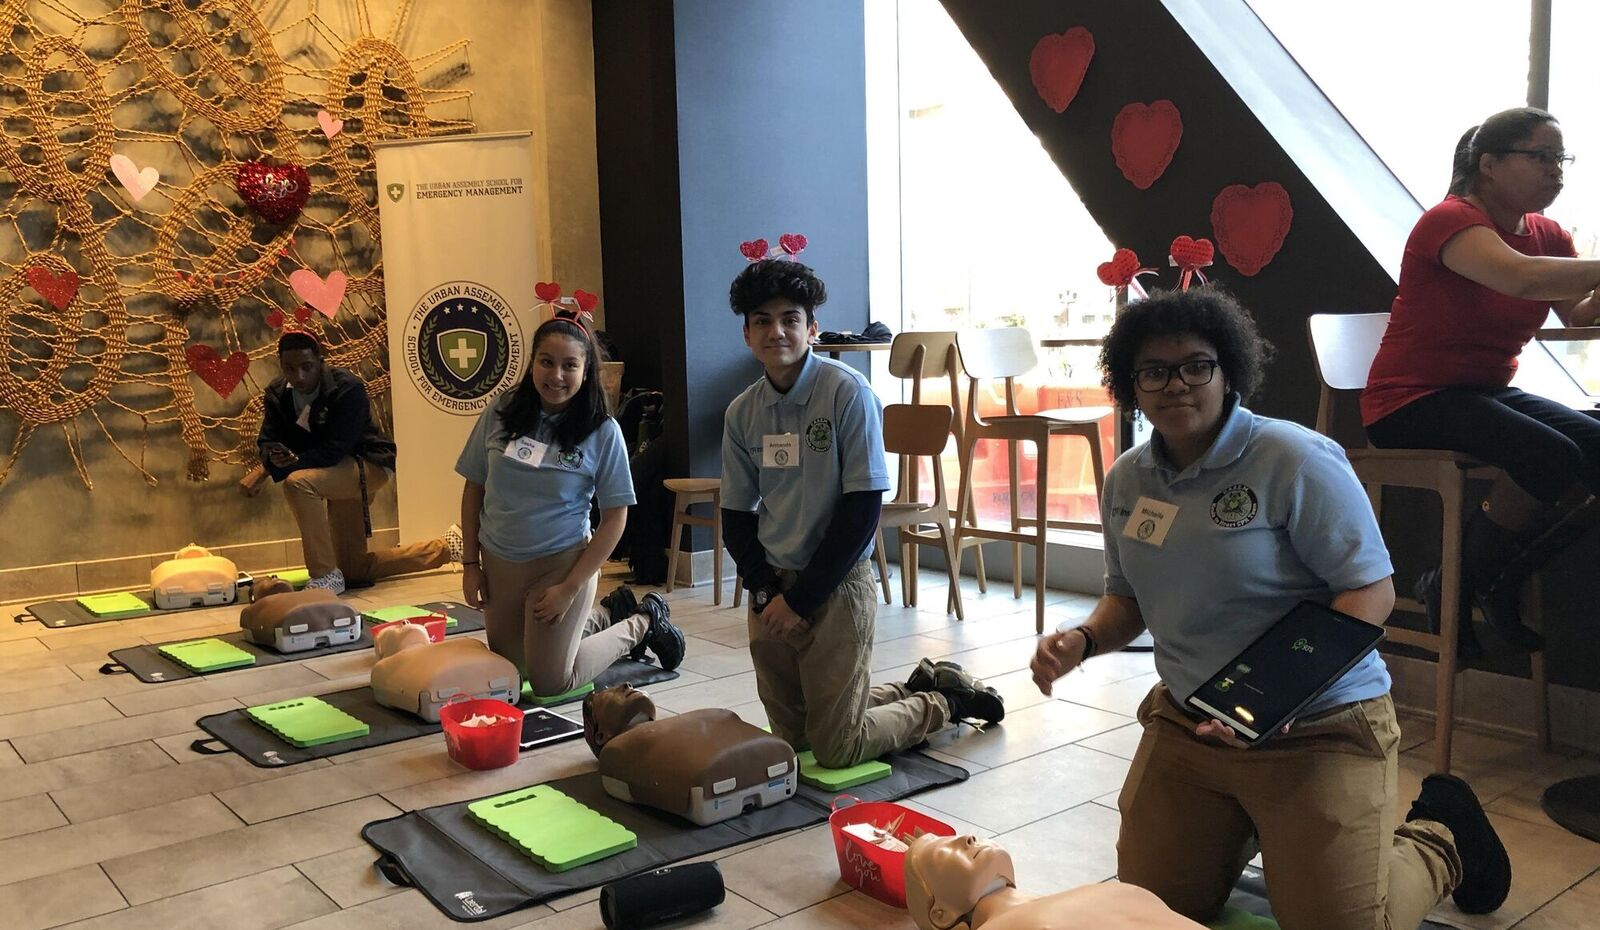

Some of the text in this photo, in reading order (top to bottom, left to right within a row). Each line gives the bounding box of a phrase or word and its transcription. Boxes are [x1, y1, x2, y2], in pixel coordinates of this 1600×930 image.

[416, 178, 523, 191] THE URBAN ASSEMBLY SCHOOL FOR
[416, 186, 523, 199] EMERGENCY MANAGEMENT
[413, 285, 511, 322] THE URBAN ASSEMBLY
[407, 335, 421, 375] SCHOOL
[417, 375, 433, 395] FOR
[431, 391, 488, 411] EMERGENCY
